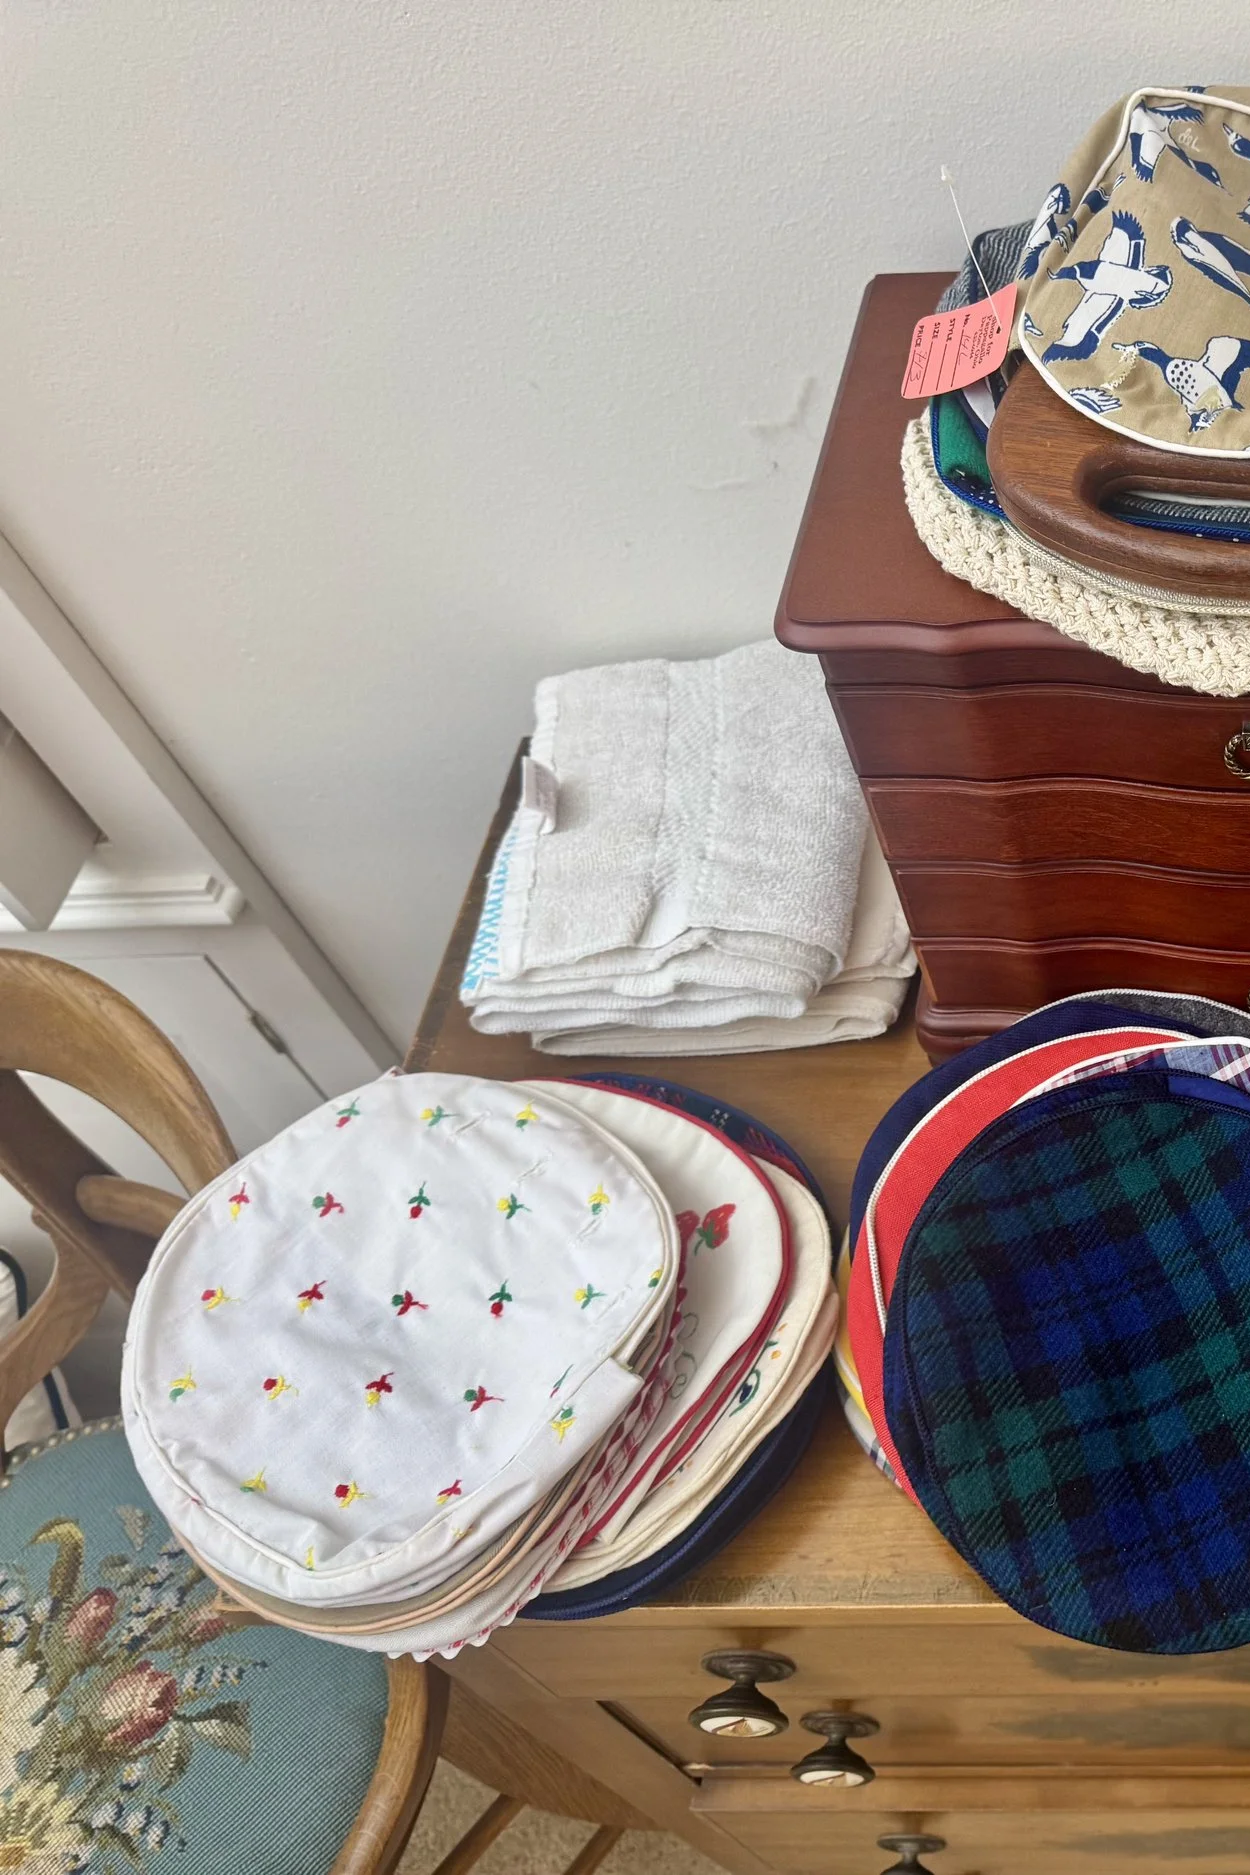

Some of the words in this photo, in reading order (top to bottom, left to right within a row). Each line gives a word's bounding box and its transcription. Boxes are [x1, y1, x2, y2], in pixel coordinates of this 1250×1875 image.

[963, 314, 971, 327] No.
[915, 325, 924, 347] PRICE
[932, 322, 941, 339] SIZE
[946, 318, 956, 342] STYLE
[986, 341, 994, 357] for
